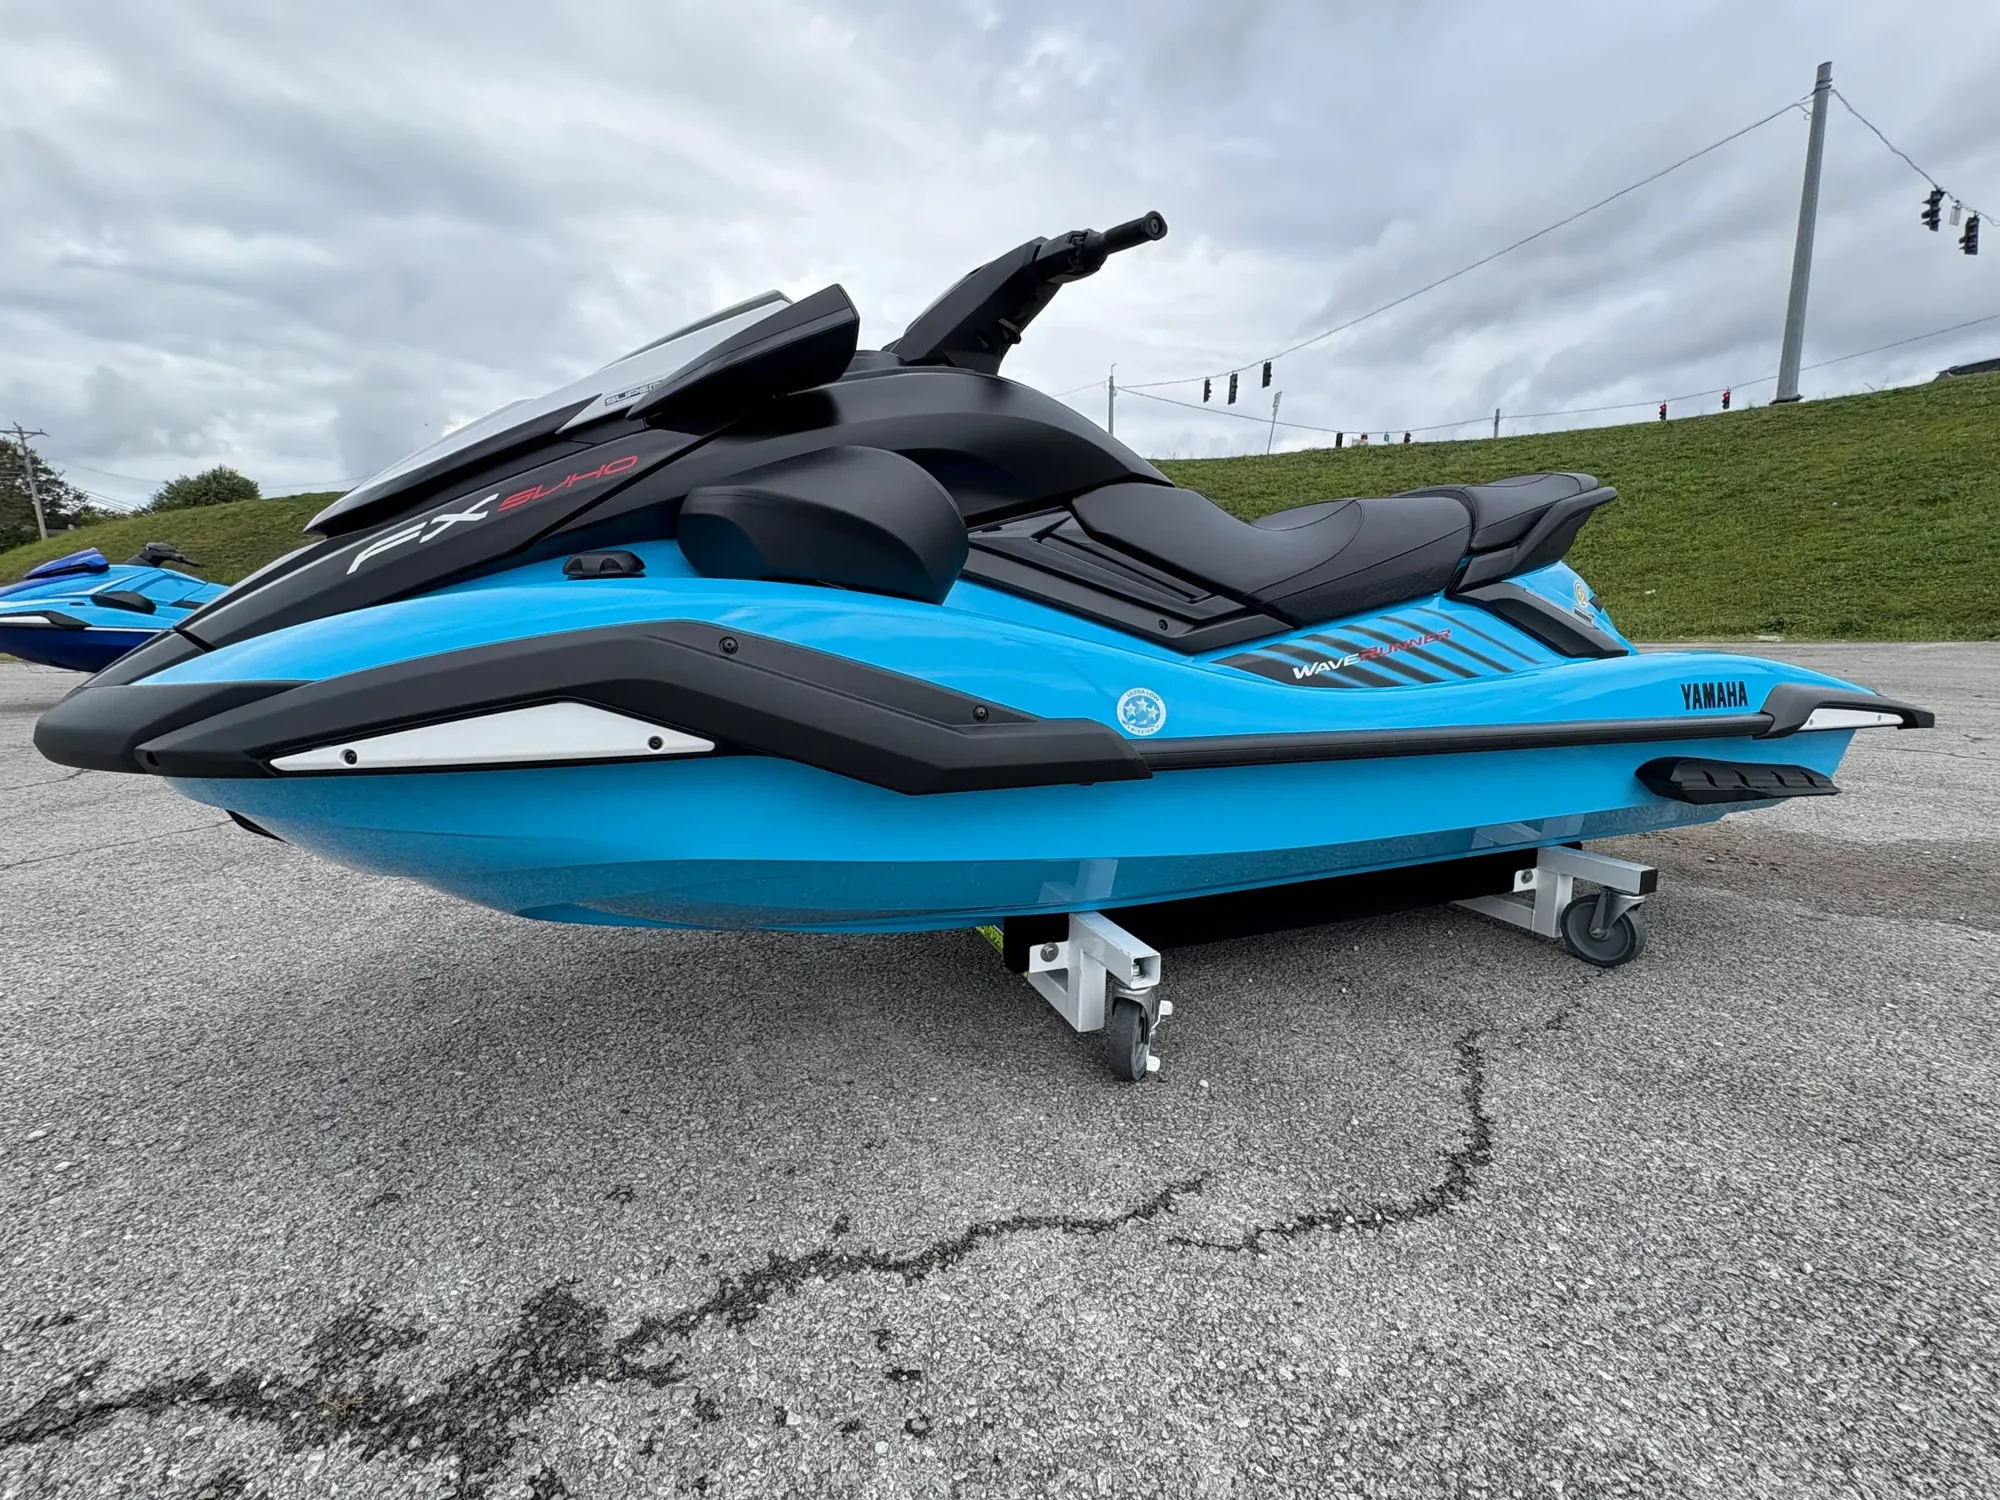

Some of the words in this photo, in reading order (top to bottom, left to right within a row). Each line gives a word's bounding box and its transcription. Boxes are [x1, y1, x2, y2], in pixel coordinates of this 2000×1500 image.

[346, 493, 499, 575] FX
[1292, 629, 1451, 680] WAVERUNNER
[1681, 681, 1748, 711] YAMAHA
